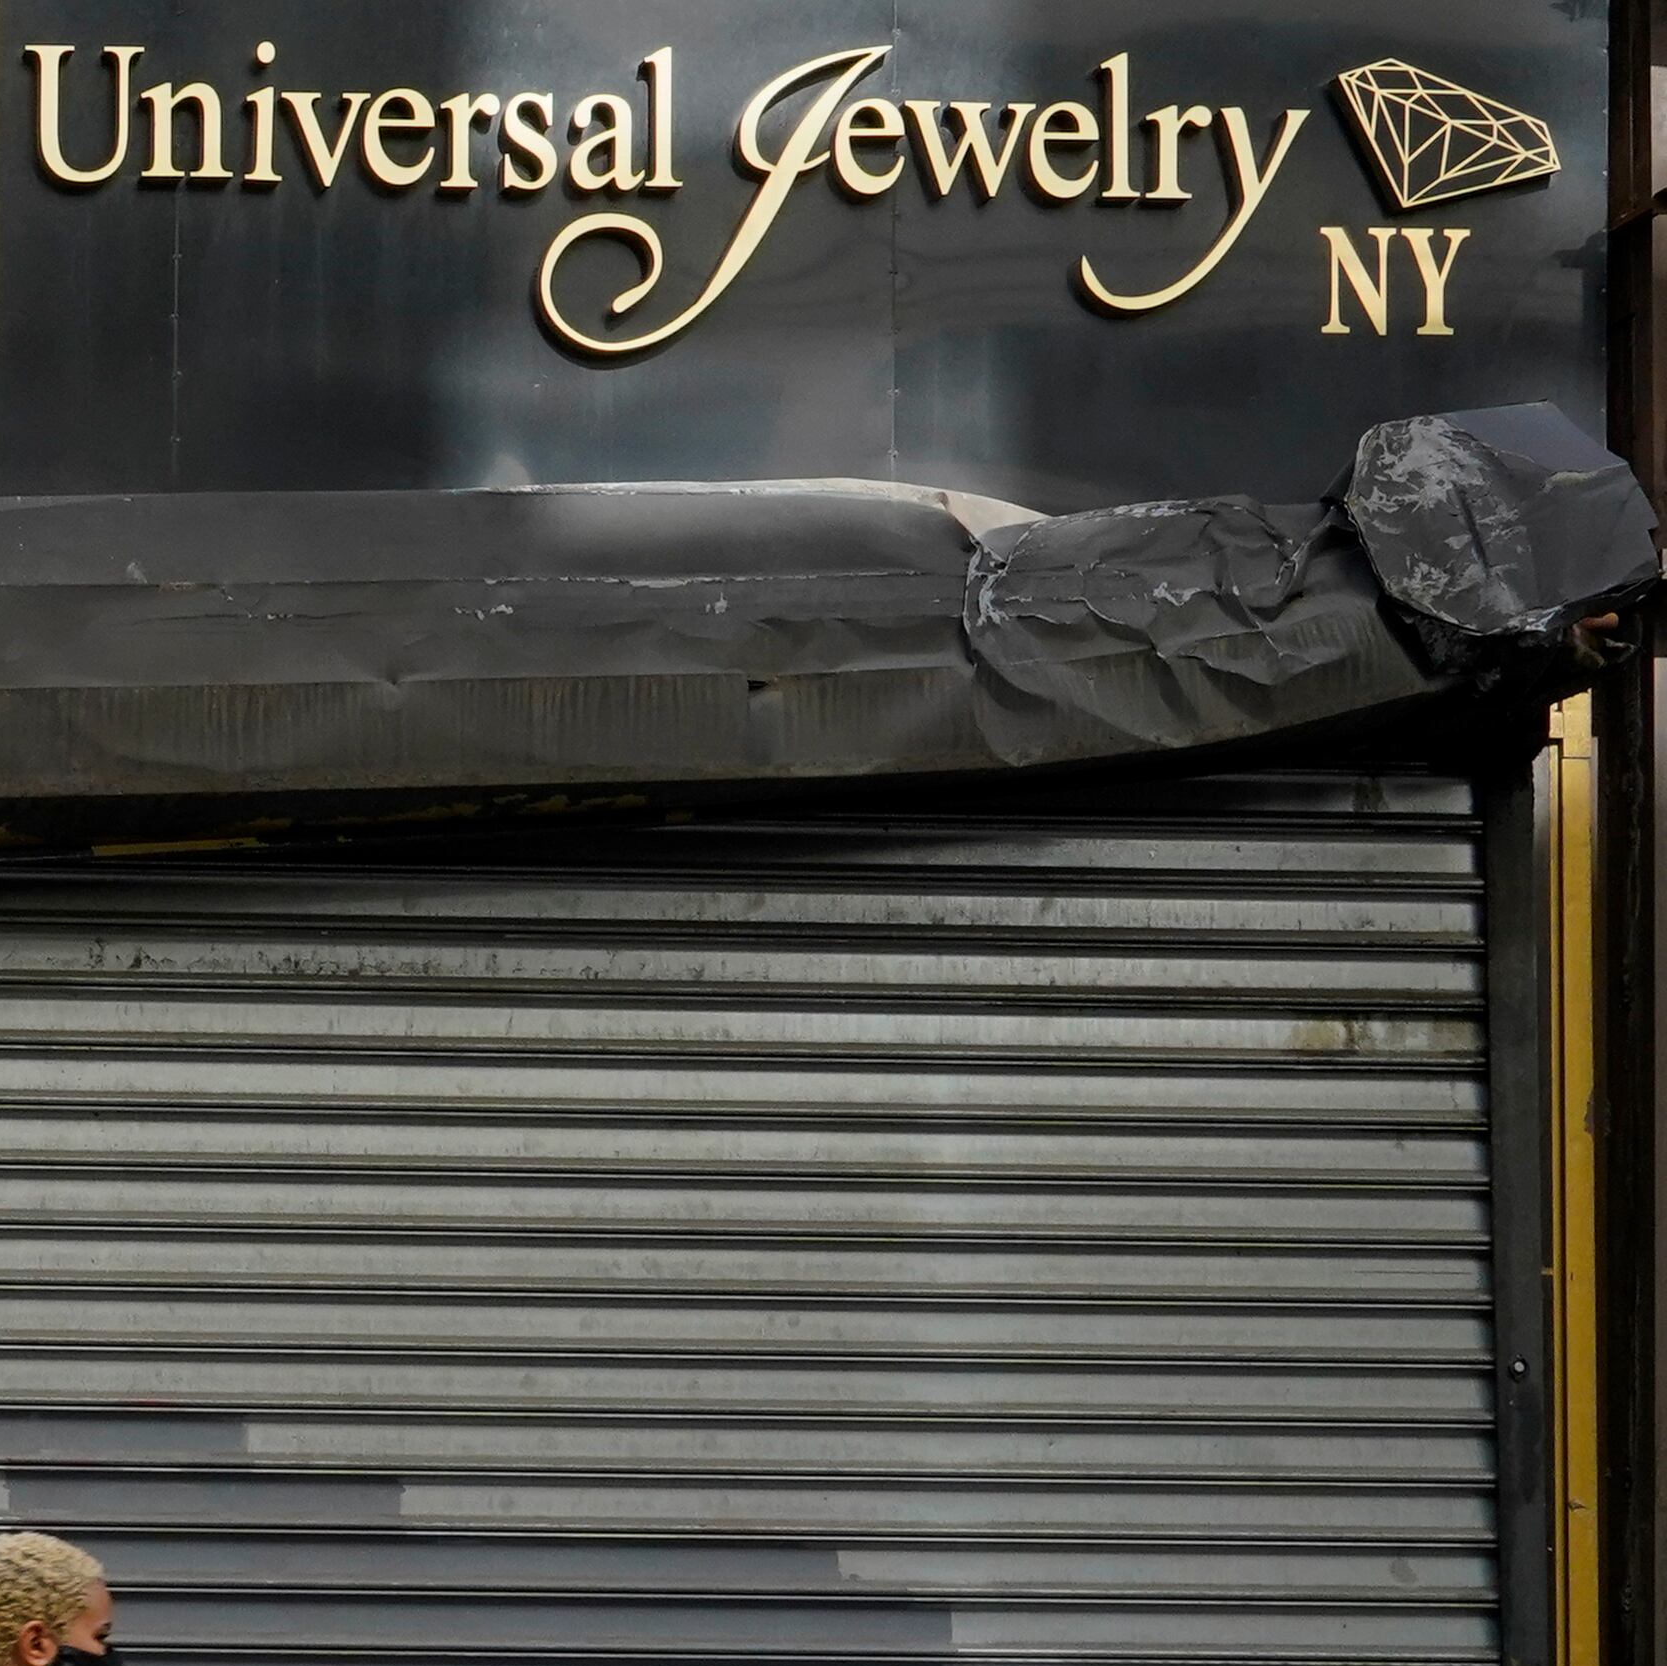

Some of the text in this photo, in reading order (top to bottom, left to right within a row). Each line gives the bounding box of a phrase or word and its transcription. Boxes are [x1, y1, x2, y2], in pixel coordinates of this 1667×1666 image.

[23, 40, 1312, 352] Universal Jewelry
[1319, 226, 1471, 336] NY
